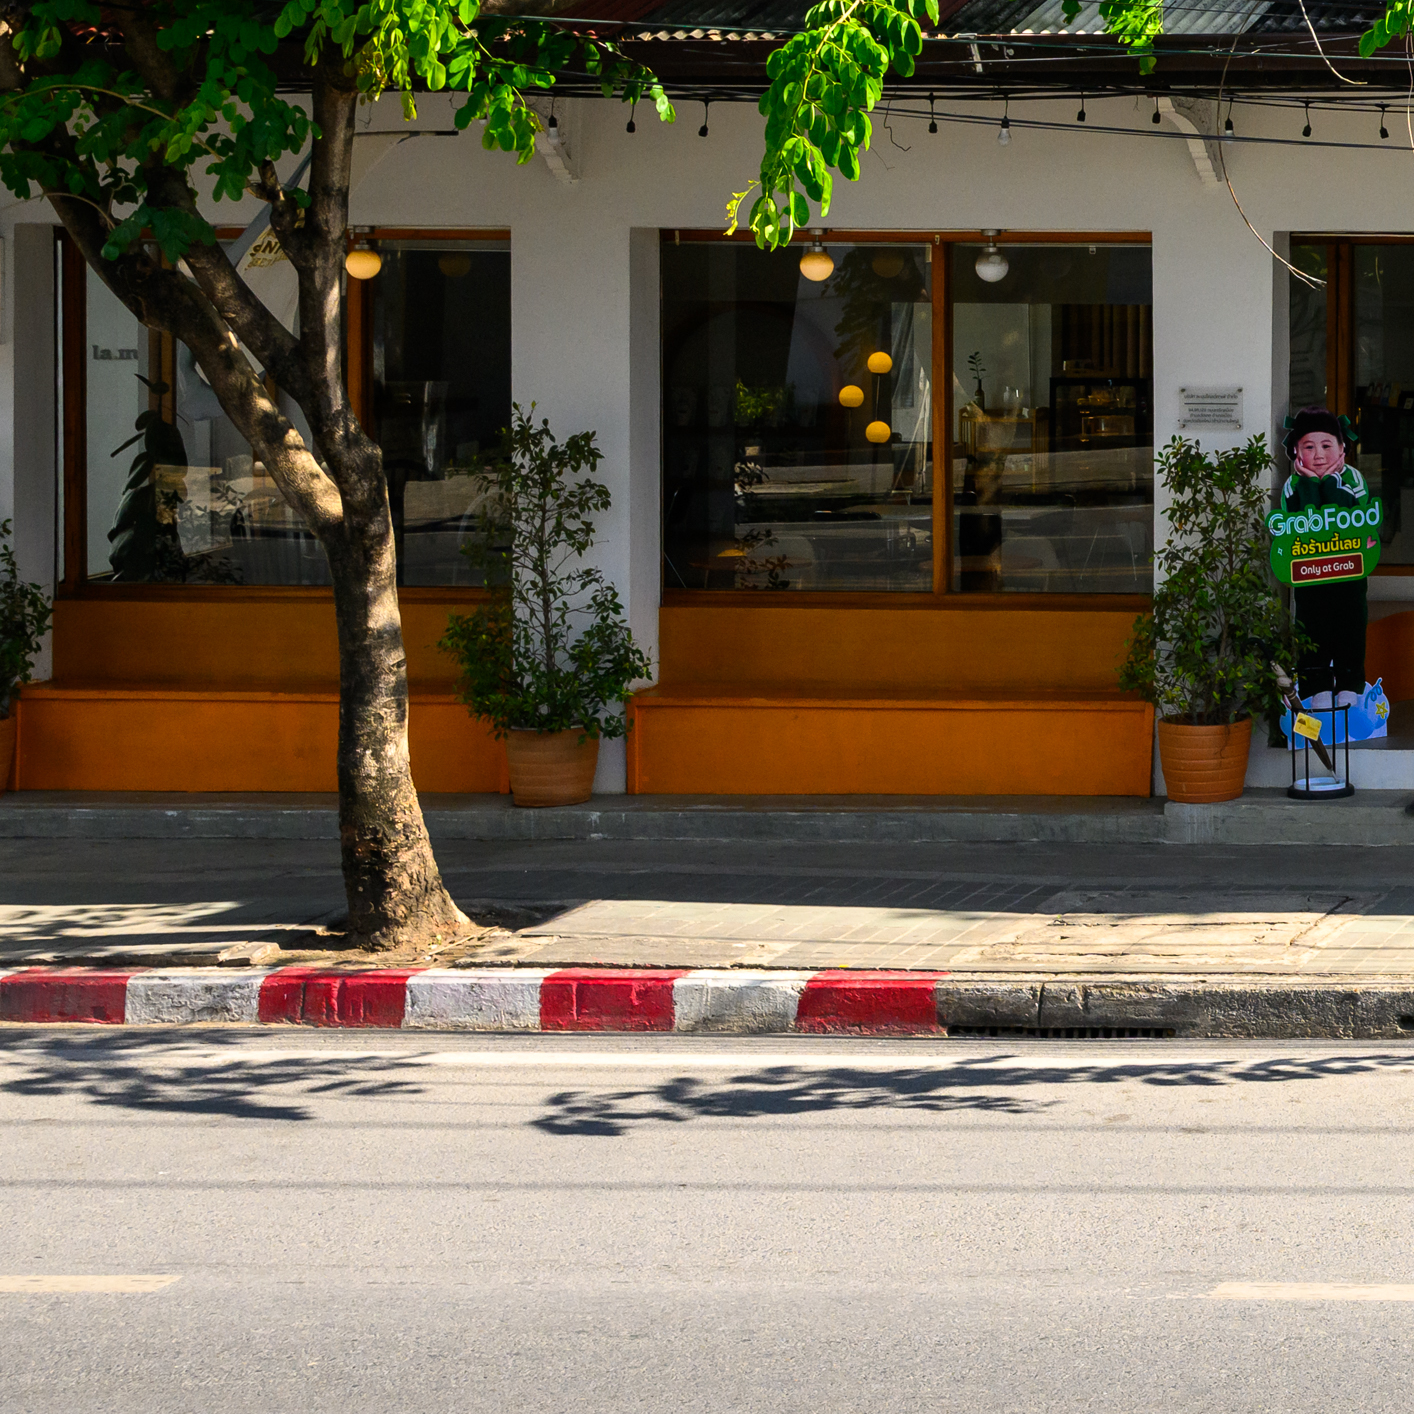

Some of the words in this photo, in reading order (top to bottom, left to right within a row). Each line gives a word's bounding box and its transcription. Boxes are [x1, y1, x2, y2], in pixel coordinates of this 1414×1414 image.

[1268, 501, 1381, 536] GrabFood
[1292, 532, 1362, 557] สั่งร้านนี้เลย
[1300, 565, 1321, 576] Only
[1322, 563, 1332, 573] at
[1333, 561, 1355, 571] Grab
